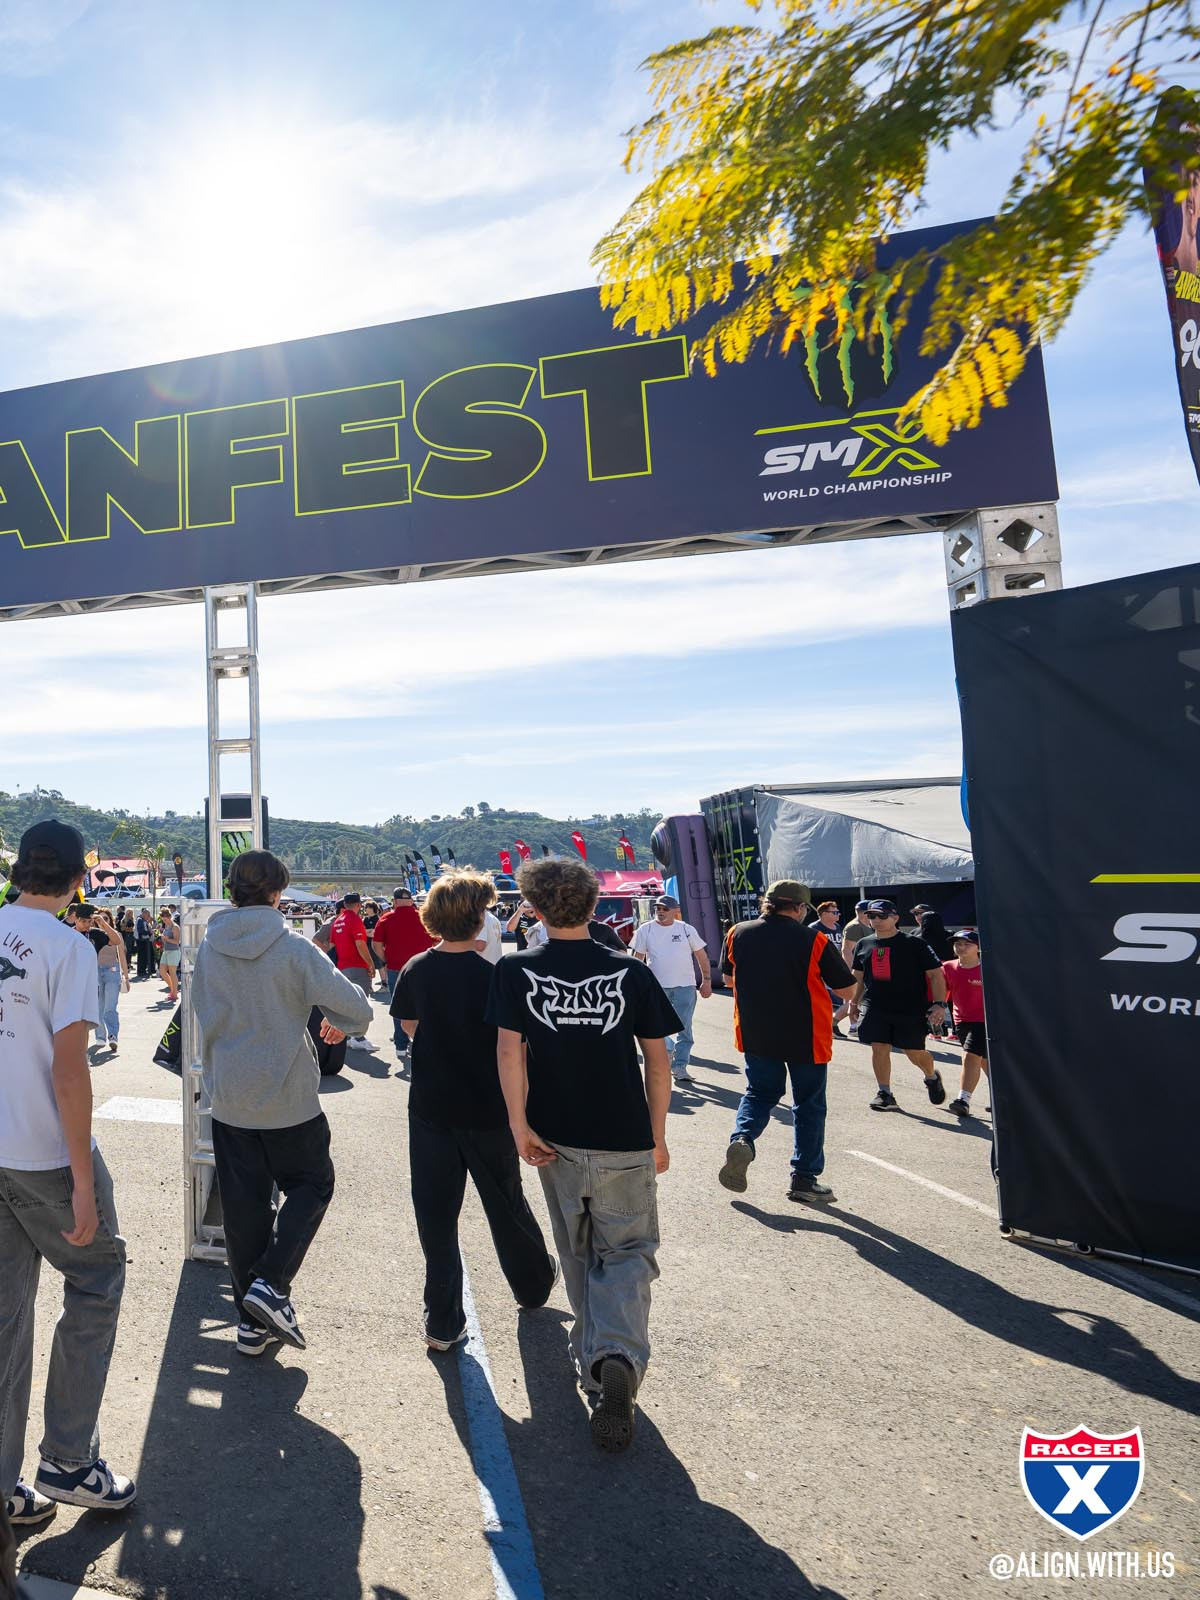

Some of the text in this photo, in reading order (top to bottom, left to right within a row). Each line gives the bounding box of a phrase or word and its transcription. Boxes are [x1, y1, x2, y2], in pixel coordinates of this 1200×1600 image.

[759, 420, 942, 477] SMX
[763, 472, 952, 501] WORLD CHAMPIONSHIP
[3, 932, 33, 961] LIKE
[1110, 993, 1200, 1016] WOR
[556, 1017, 603, 1026] MOTO
